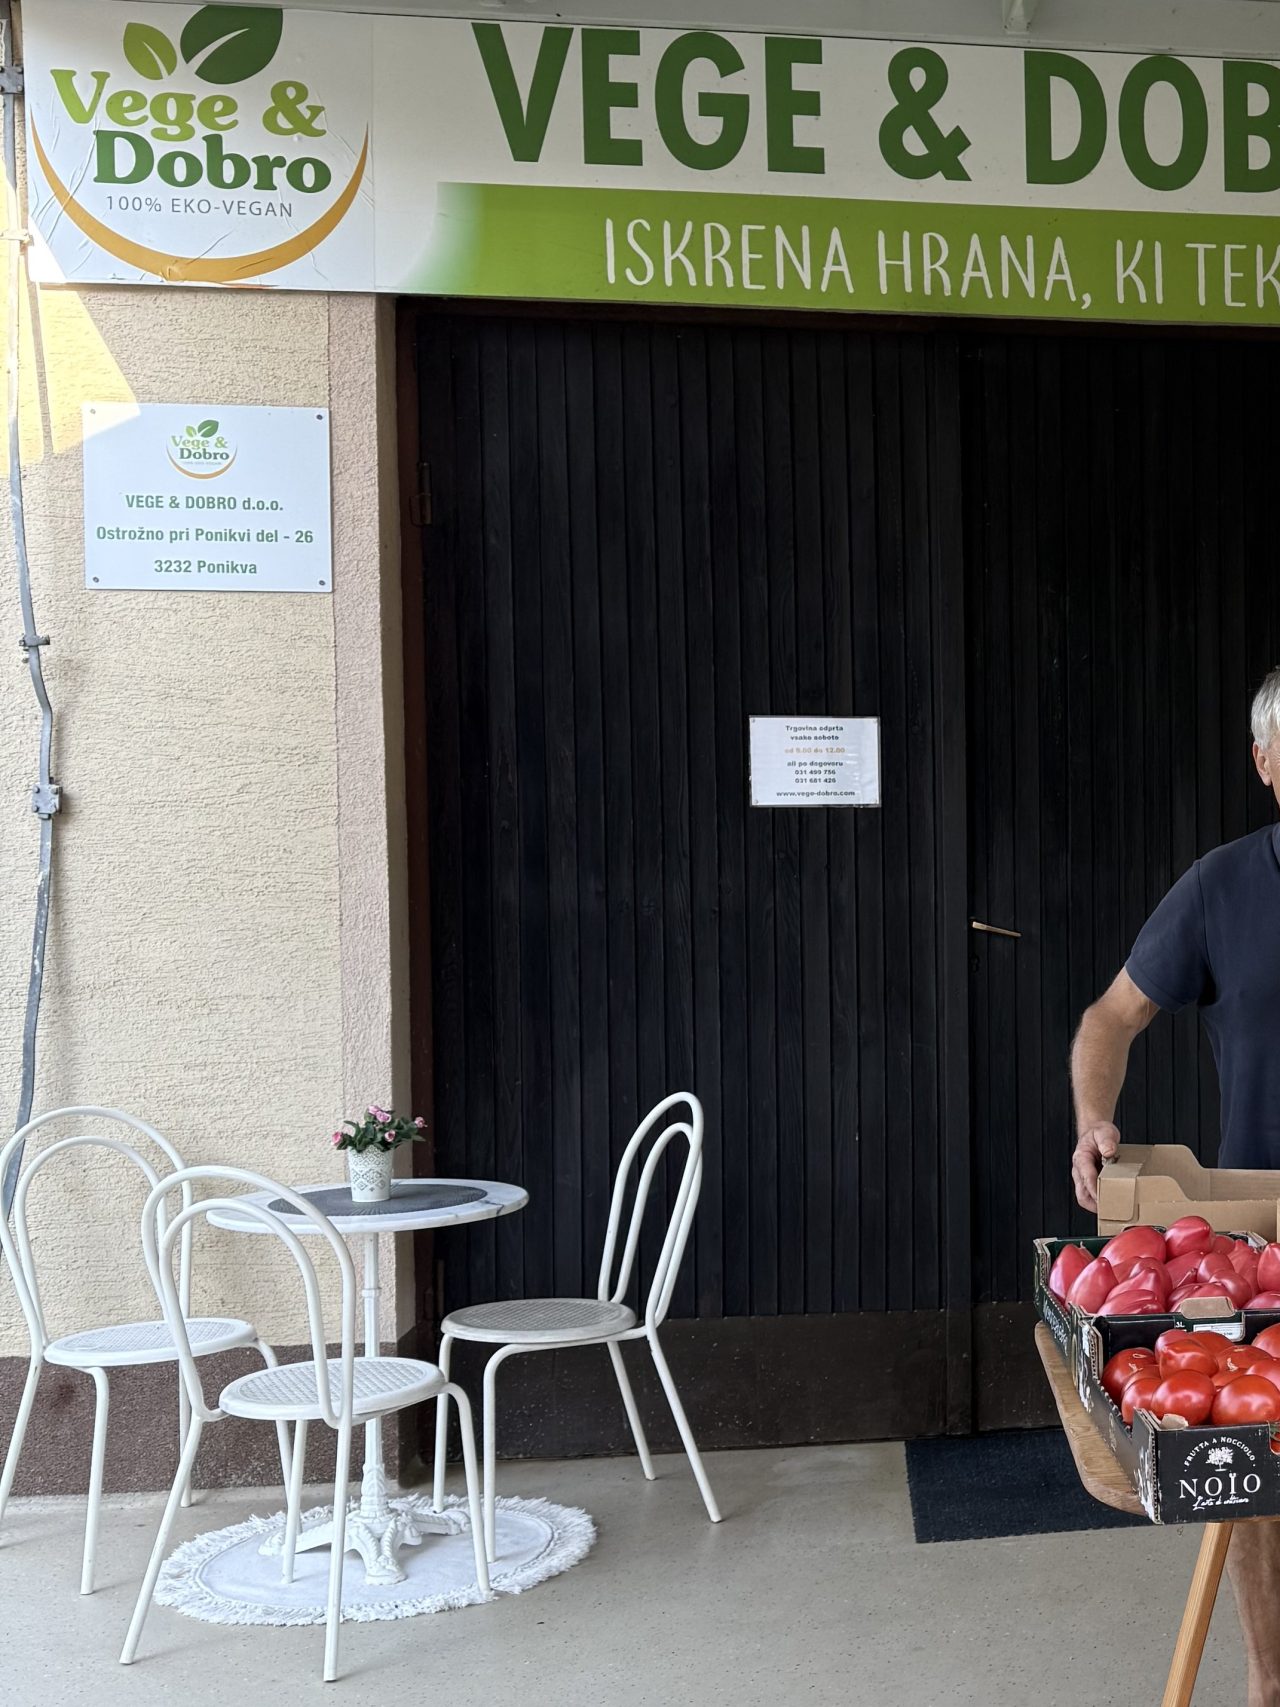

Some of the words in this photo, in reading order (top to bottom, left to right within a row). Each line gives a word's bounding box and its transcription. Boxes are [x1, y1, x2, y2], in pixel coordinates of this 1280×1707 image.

[50, 69, 239, 142] Vege
[262, 80, 327, 138] &
[471, 22, 826, 174] VEGE
[878, 46, 972, 182] &
[93, 130, 332, 194] Dobro
[106, 195, 162, 213] 100%
[171, 197, 293, 218] EKO-VEGAN
[605, 217, 855, 294] ISKRENA
[877, 229, 1093, 310] HRANA,
[1115, 238, 1164, 304] KI
[171, 435, 210, 450] Vege
[214, 436, 229, 449] &
[179, 447, 230, 461] Dobro
[125, 494, 164, 509] VEGE
[168, 495, 180, 509] &
[185, 496, 237, 511] DOBRO
[242, 498, 284, 511] d.o.o.
[96, 526, 164, 541] Ostrožno
[169, 527, 190, 544] pri
[195, 528, 251, 543] Ponikvi
[256, 529, 278, 543] del
[295, 530, 314, 544] 26
[154, 559, 192, 574] 3232
[197, 560, 257, 575] Ponikva
[785, 725, 817, 733] Trgovina
[1183, 1440, 1210, 1467] FRUTTA
[1211, 1437, 1218, 1445] A
[1220, 1435, 1257, 1462] NOCCIOLO
